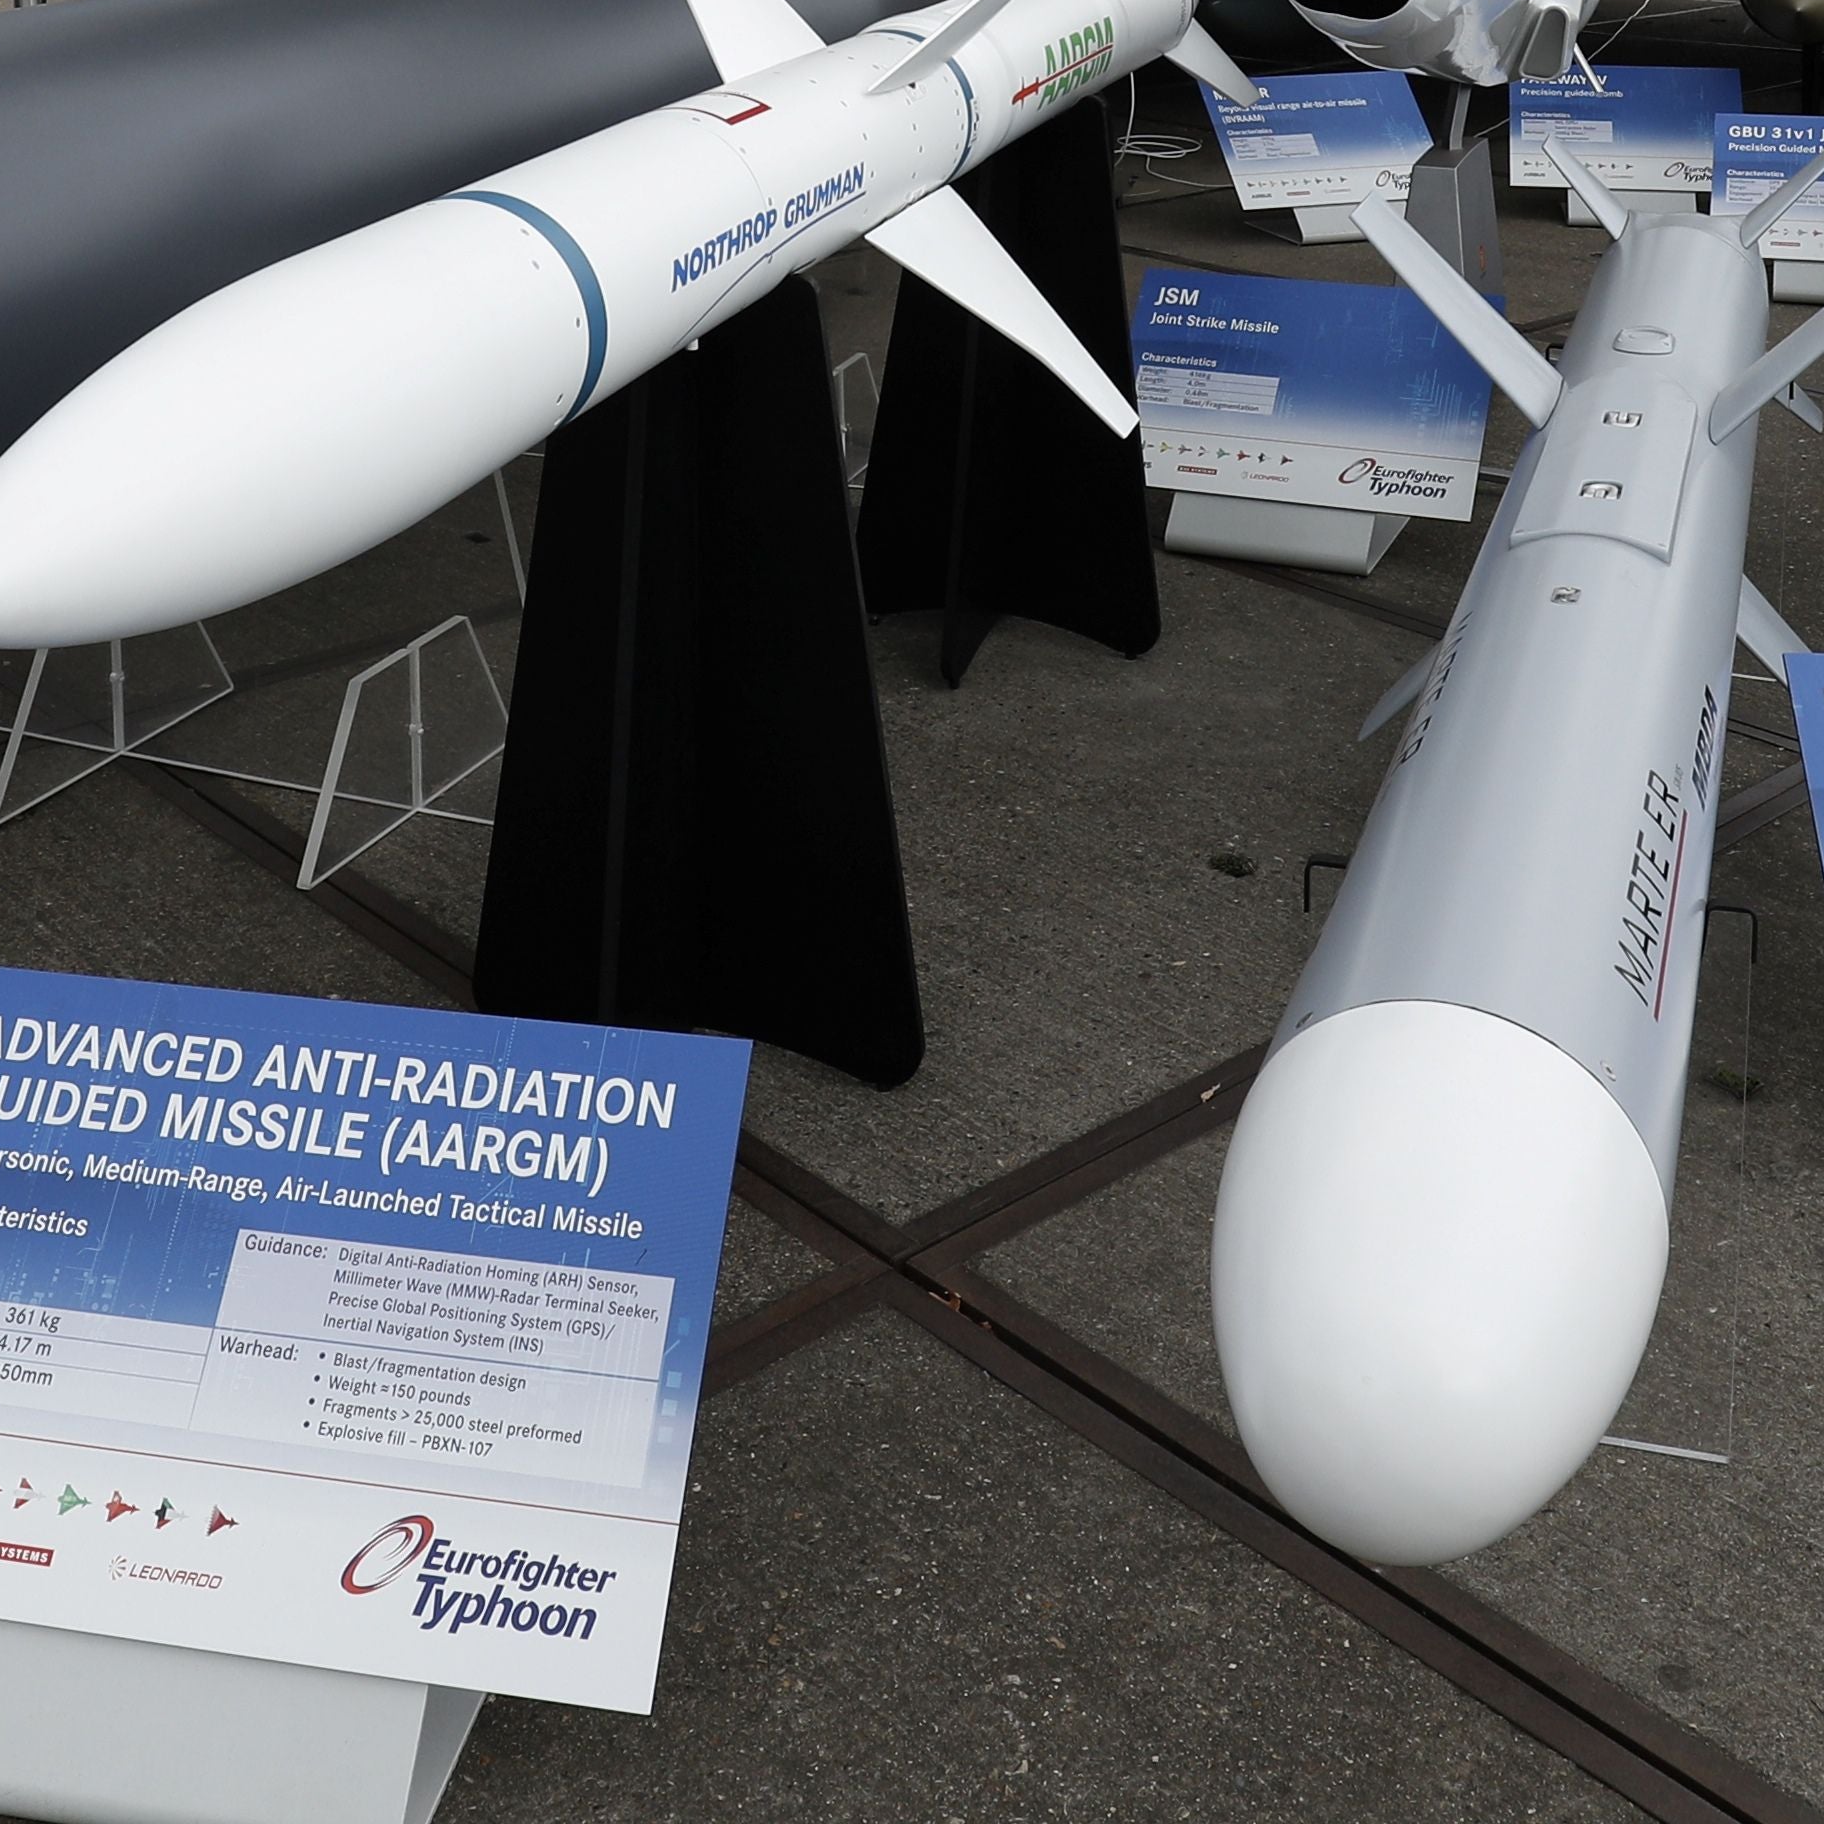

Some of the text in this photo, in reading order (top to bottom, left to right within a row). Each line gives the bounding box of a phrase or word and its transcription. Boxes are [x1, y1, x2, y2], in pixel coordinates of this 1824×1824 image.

[1728, 142, 1776, 152] Precision
[1779, 143, 1816, 154] Guided
[1729, 126, 1766, 138] GBU
[671, 162, 865, 292] NORTHROP GRUMMAN
[1154, 286, 1200, 306] JSM
[1149, 311, 1279, 334] Joint Strike Missile
[1691, 684, 1719, 811] MBDA
[1614, 769, 1679, 1007] MARTE ER
[252, 1044, 676, 1129] ANTI-RADIATION
[159, 1093, 370, 1159] MISSILE
[380, 1116, 608, 1198] (AARGM)
[82, 1154, 268, 1204] Medium-Range,
[275, 1176, 442, 1217] Air-Launched
[450, 1194, 546, 1229] Tactical
[552, 1205, 642, 1239] Missile
[245, 1233, 328, 1259] Guidance:
[338, 1247, 638, 1297] Digital Anti-Radiation Homing (ARH) Sensor,
[328, 1291, 616, 1340] Precise Global Positioning System (GPS)/
[333, 1269, 659, 1323] Millimeter Wave (MMW)-Radar Terminal Seeker,
[5, 1306, 35, 1325] 361
[39, 1311, 61, 1334] kg
[323, 1313, 544, 1356] Inertial Navigation System (INS)
[35, 1343, 52, 1356] m
[220, 1335, 299, 1361] Warhead:
[329, 1375, 377, 1396] Weight
[418, 1390, 471, 1406] pounds
[333, 1352, 526, 1392] Blast/fragmentation design
[318, 1421, 384, 1444] Explosive
[387, 1430, 406, 1446] fill
[421, 1434, 493, 1456] PBXN-107
[323, 1398, 582, 1444] Fragments > 25,000 steel preformed
[422, 1533, 617, 1593] Eurofighter
[412, 1573, 597, 1640] Typhoon
